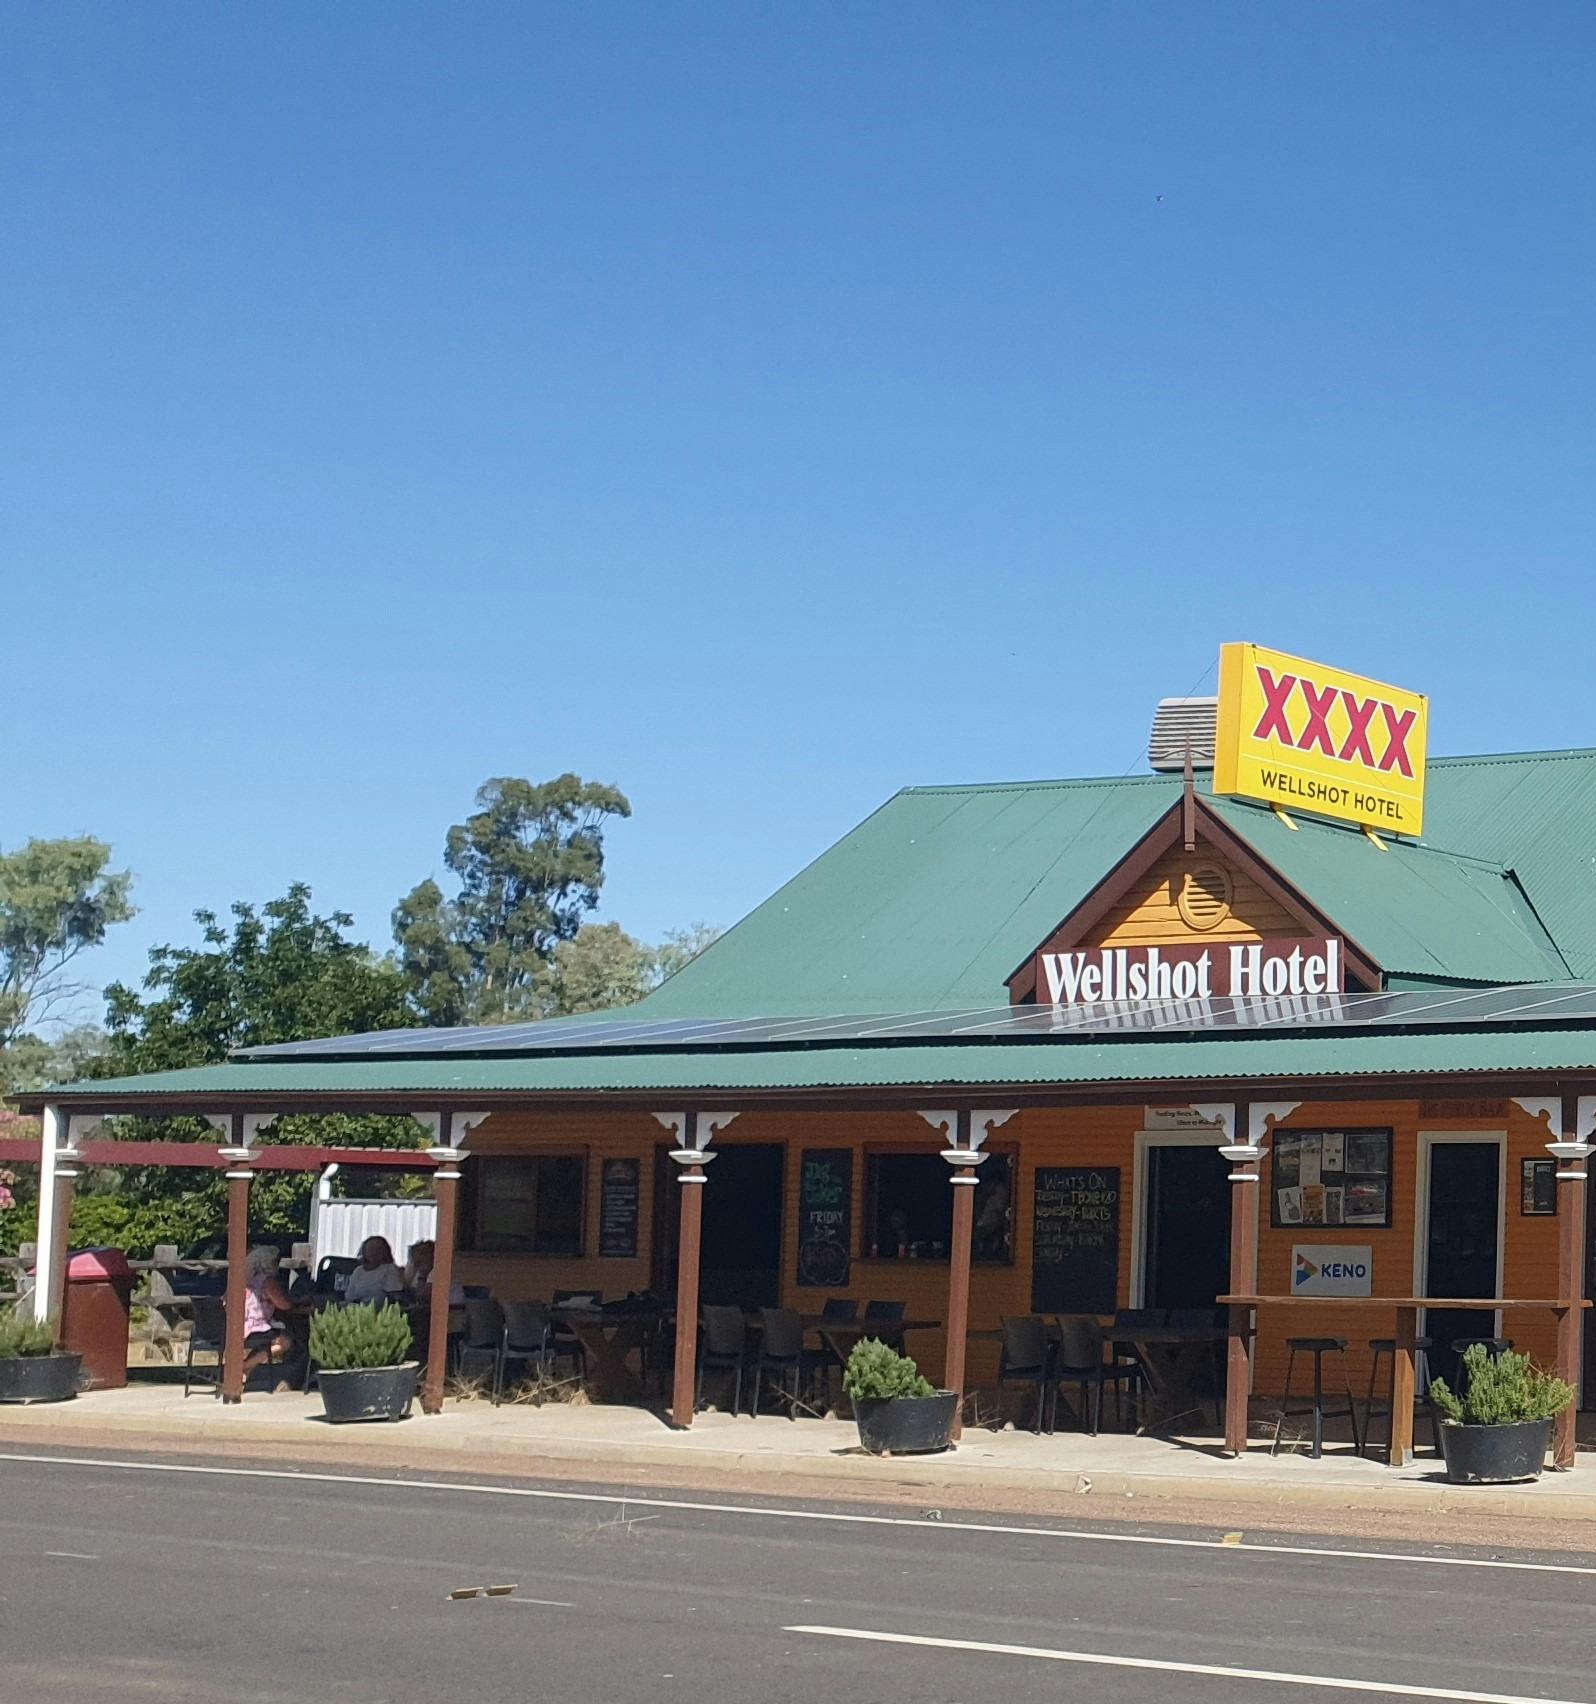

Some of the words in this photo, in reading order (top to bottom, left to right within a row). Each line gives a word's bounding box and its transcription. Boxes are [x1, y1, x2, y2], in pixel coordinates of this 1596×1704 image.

[1252, 665, 1418, 779] XXXX
[1260, 768, 1350, 806] WELLSHOT
[1354, 793, 1404, 821] HOTEL
[1042, 947, 1213, 1004] Wellshot
[1228, 939, 1340, 998] Hotel
[809, 1210, 844, 1225] FRIDAY
[1321, 1263, 1366, 1278] KENO
